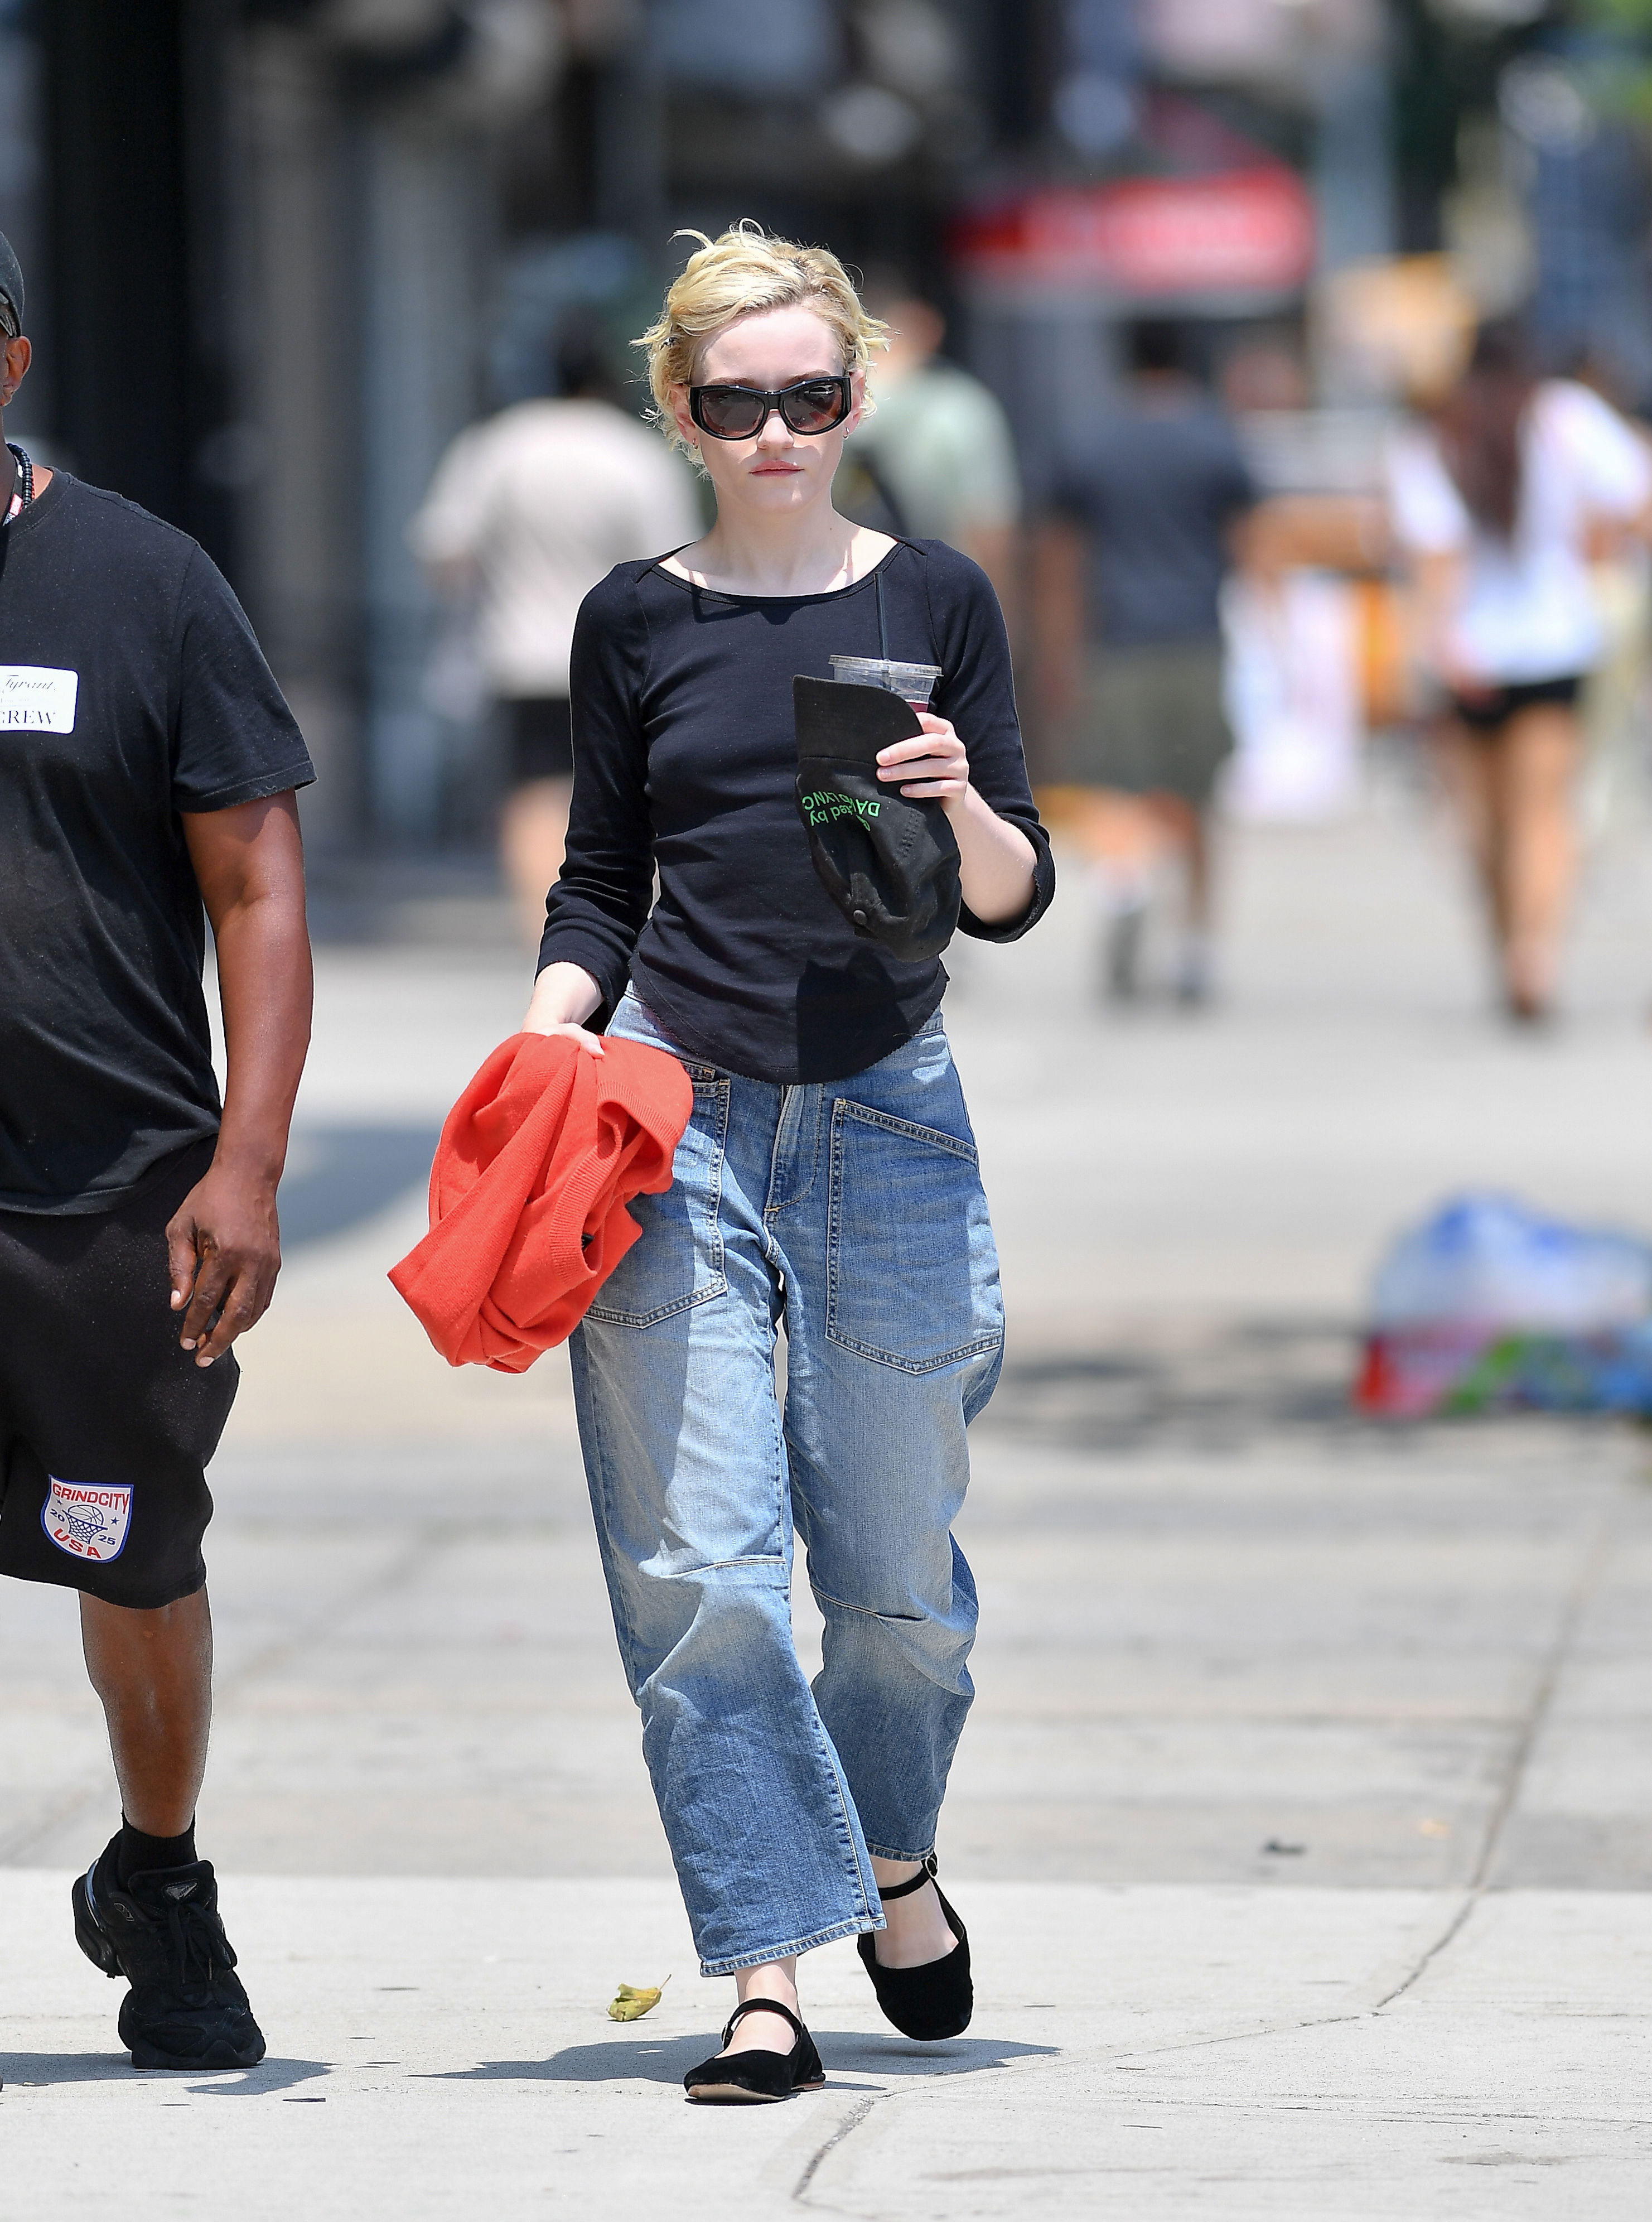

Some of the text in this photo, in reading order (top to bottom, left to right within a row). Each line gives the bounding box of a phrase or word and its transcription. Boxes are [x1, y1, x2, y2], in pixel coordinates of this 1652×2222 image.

[810, 809, 829, 826] by
[52, 1483, 129, 1514] GRINDCITY
[50, 1508, 116, 1545] 20 25
[54, 1528, 102, 1559] USA
